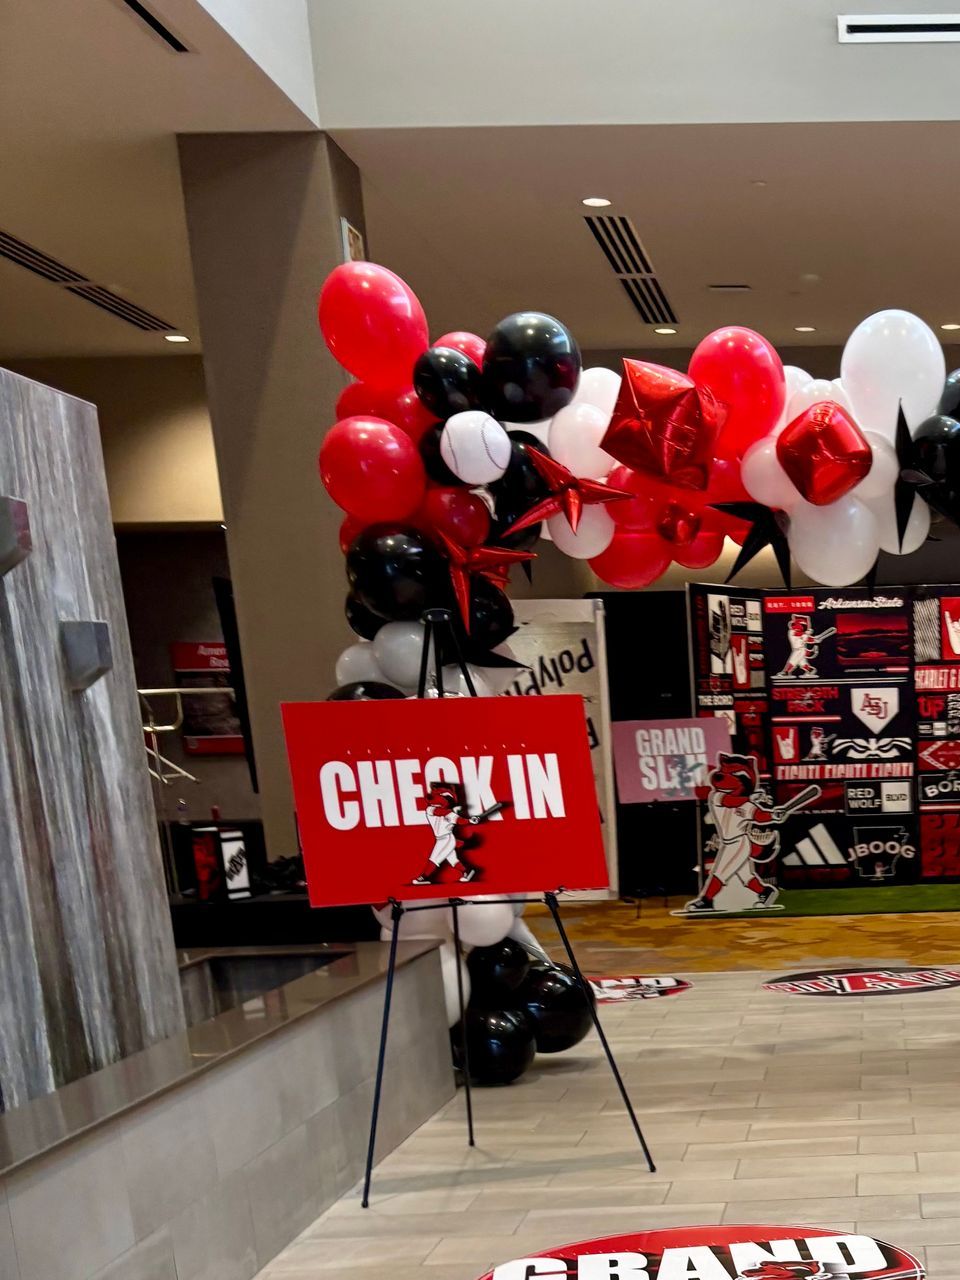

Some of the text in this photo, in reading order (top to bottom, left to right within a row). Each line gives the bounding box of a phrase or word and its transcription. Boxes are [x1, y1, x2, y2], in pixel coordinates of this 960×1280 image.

[817, 597, 904, 609] Arkansas State
[635, 727, 706, 756] GRAND
[507, 753, 566, 820] IN
[848, 788, 875, 799] RED
[848, 799, 882, 809] WOLF
[848, 841, 916, 862] JBOOG
